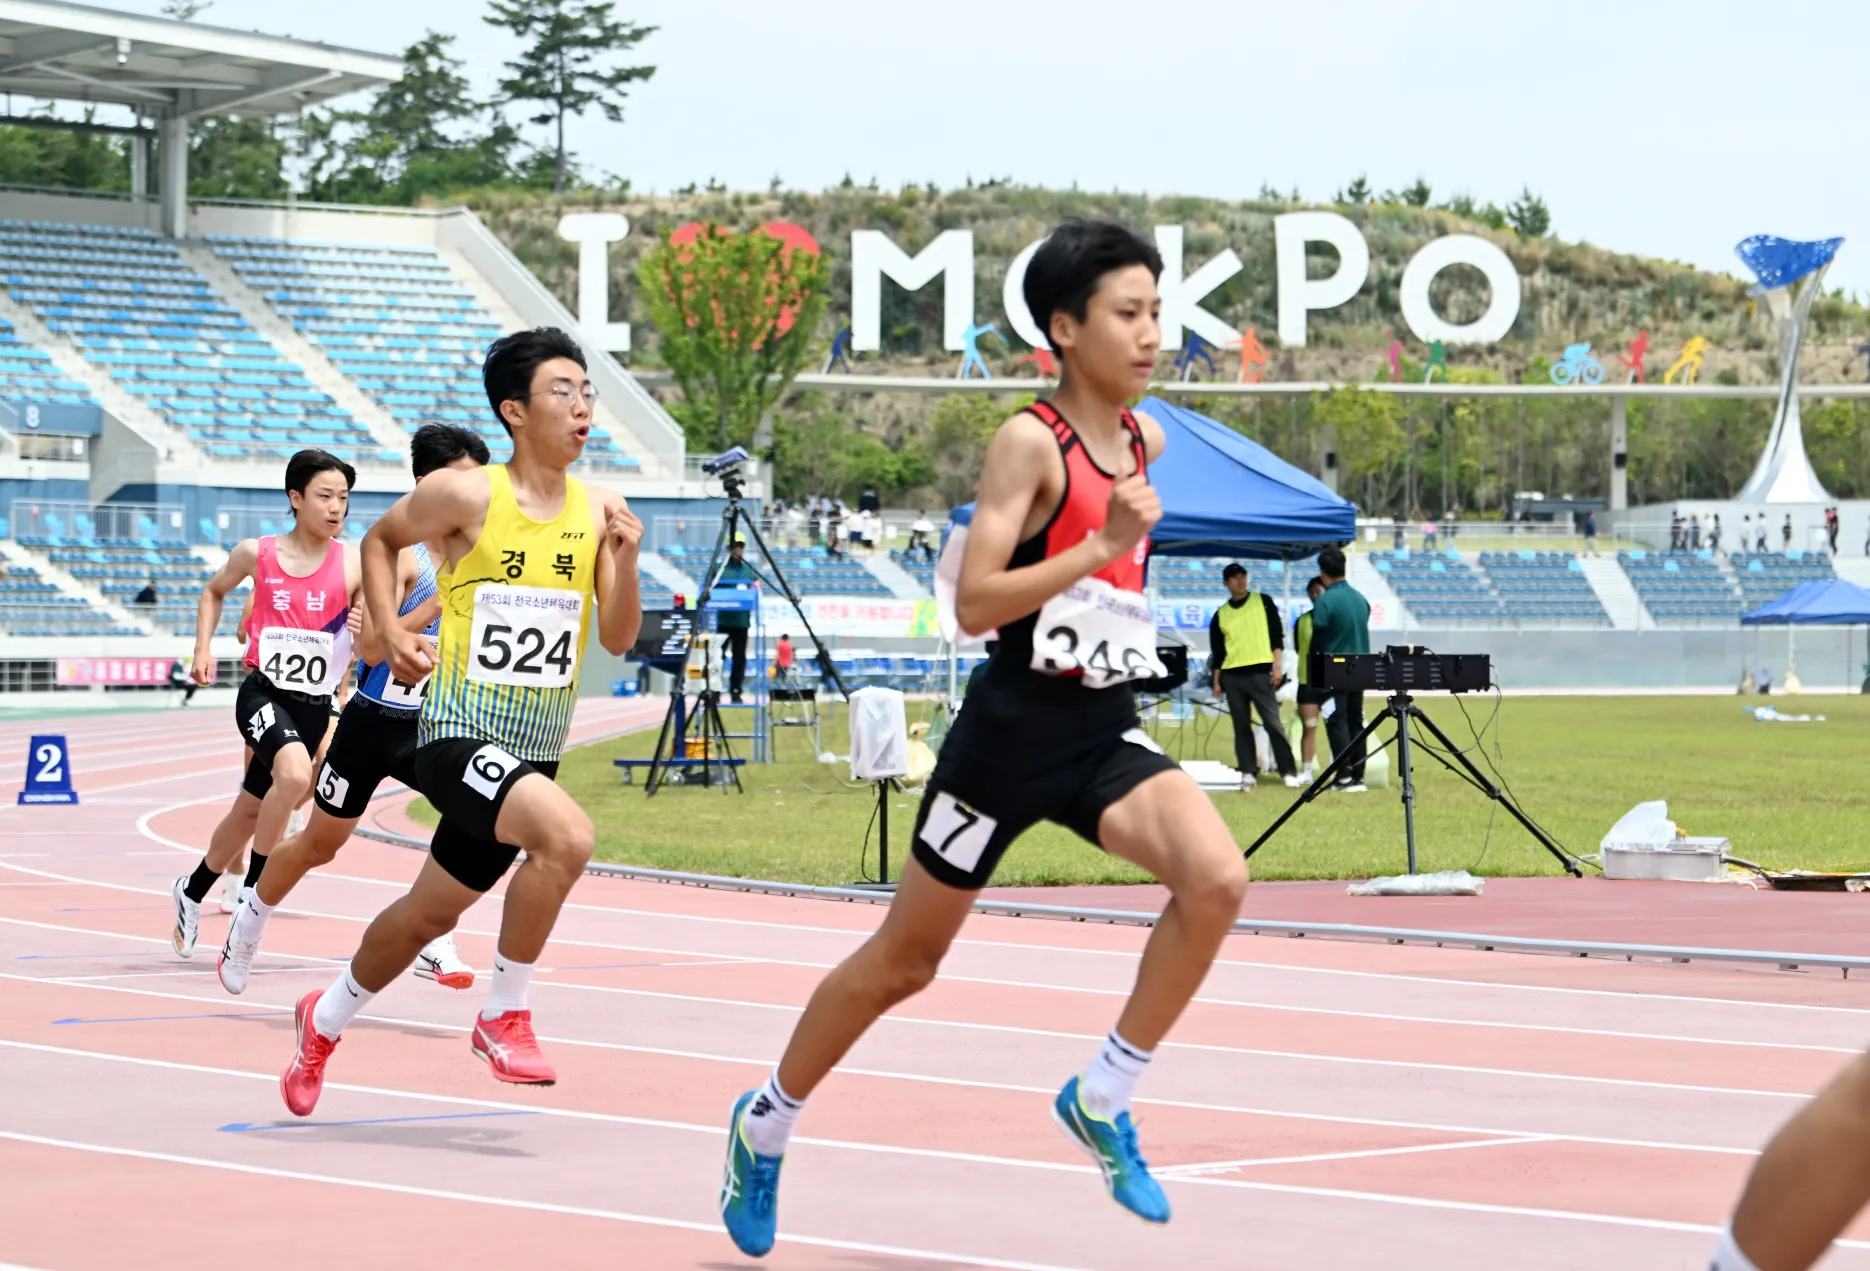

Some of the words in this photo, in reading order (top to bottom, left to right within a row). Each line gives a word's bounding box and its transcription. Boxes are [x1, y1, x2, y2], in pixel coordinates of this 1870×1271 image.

[558, 213, 631, 351] I
[26, 405, 40, 428] 8
[480, 592, 511, 606] 제53회
[477, 623, 572, 676] 524
[264, 652, 327, 686] 420
[257, 710, 266, 732] 4
[34, 743, 63, 782] 2
[472, 754, 506, 783] 6
[322, 769, 340, 801] 5
[940, 802, 979, 854] 7
